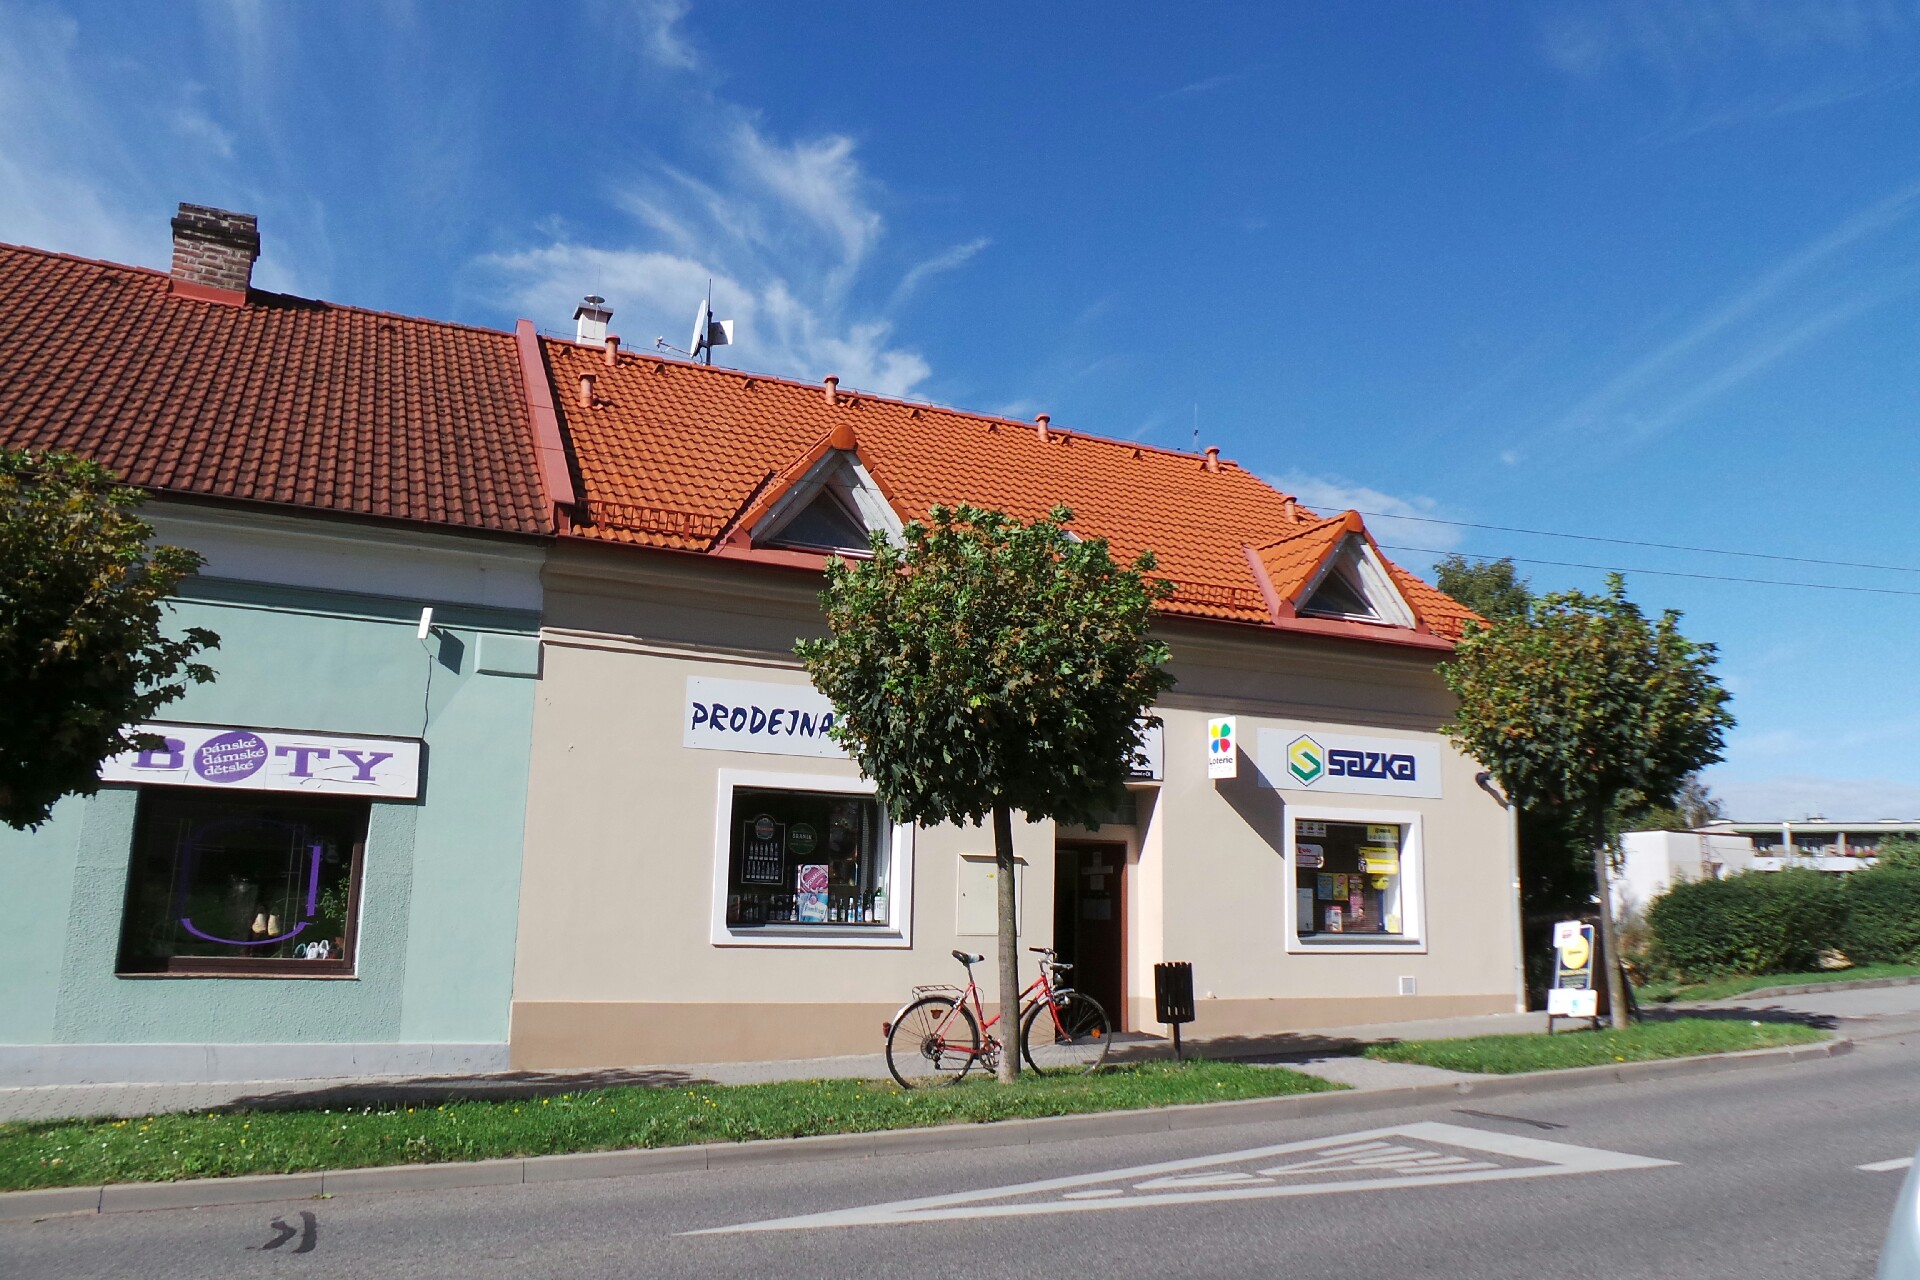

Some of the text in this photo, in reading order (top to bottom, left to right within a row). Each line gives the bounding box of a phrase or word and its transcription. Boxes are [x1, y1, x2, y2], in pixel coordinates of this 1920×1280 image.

[691, 701, 835, 739] PRODEJNA
[202, 737, 257, 757] pánské
[202, 746, 265, 765] dámské
[203, 760, 254, 777] dětské
[1209, 755, 1234, 766] Loterie
